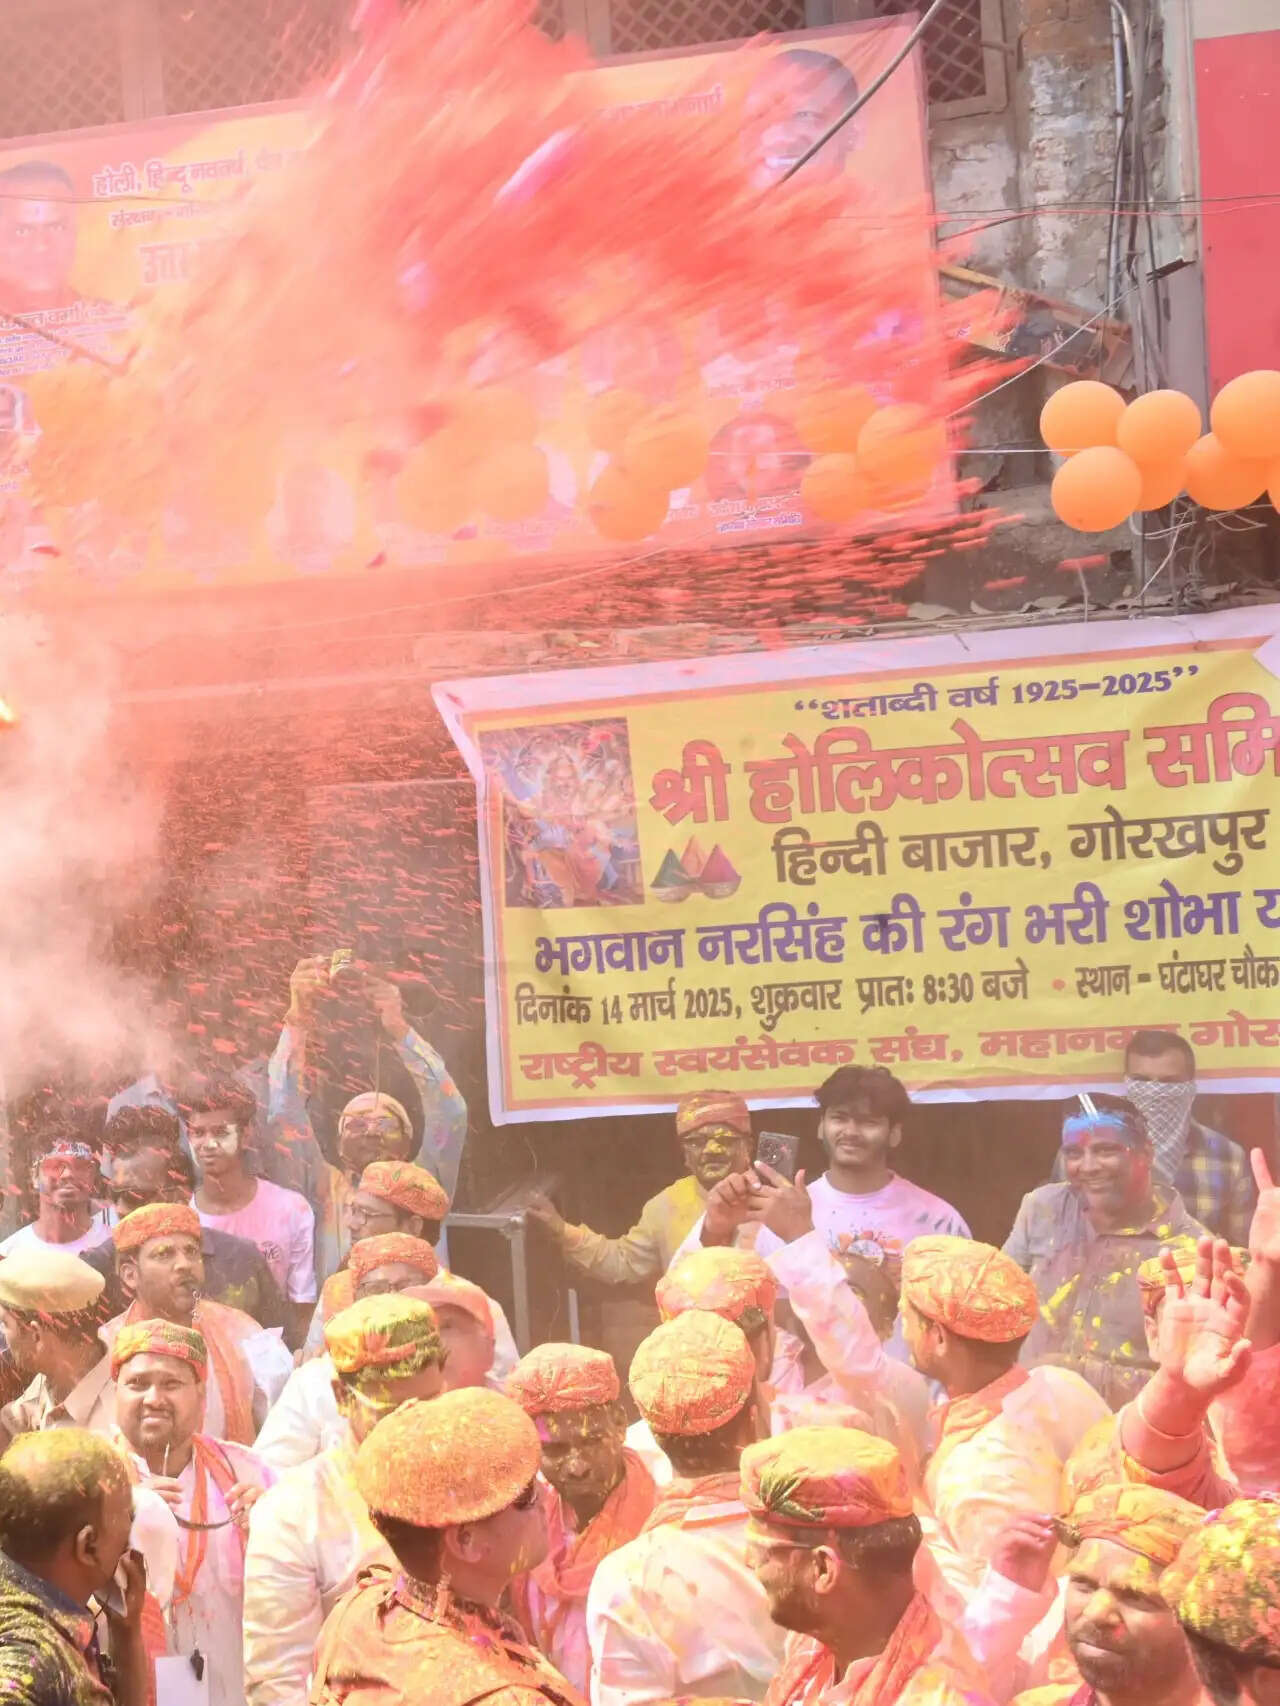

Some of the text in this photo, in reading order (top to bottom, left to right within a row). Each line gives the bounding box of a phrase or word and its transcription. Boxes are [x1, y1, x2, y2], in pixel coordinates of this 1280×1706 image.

[794, 682, 938, 720] “शताब्दी
[948, 677, 1000, 708] वर्ष
[648, 739, 732, 826] श्री
[744, 717, 1130, 824] होलिकोत्सव
[770, 804, 1271, 887] हिन्दी बाजार, गोरखपुर
[534, 927, 686, 976] भगवान
[695, 902, 848, 966] नरसिंह
[859, 893, 926, 954] की
[937, 891, 1011, 952] रंग
[1024, 881, 1109, 945] भरी
[1123, 878, 1242, 941] शोभा
[515, 982, 593, 1025] दिनांक
[601, 994, 624, 1024] 14
[628, 977, 677, 1022] मार्च
[684, 987, 743, 1020] 2025,
[750, 979, 843, 1032] शुक्रवार
[923, 972, 974, 1005] 8:30
[980, 957, 1030, 1001] बजे
[1075, 964, 1132, 998] स्थान
[1157, 950, 1227, 994] घंटाघर
[1230, 943, 1280, 989] चौक
[519, 1041, 644, 1090] राष्ट्रीय
[654, 1034, 858, 1077] स्वयंसेवक
[868, 1025, 963, 1063] संघ,
